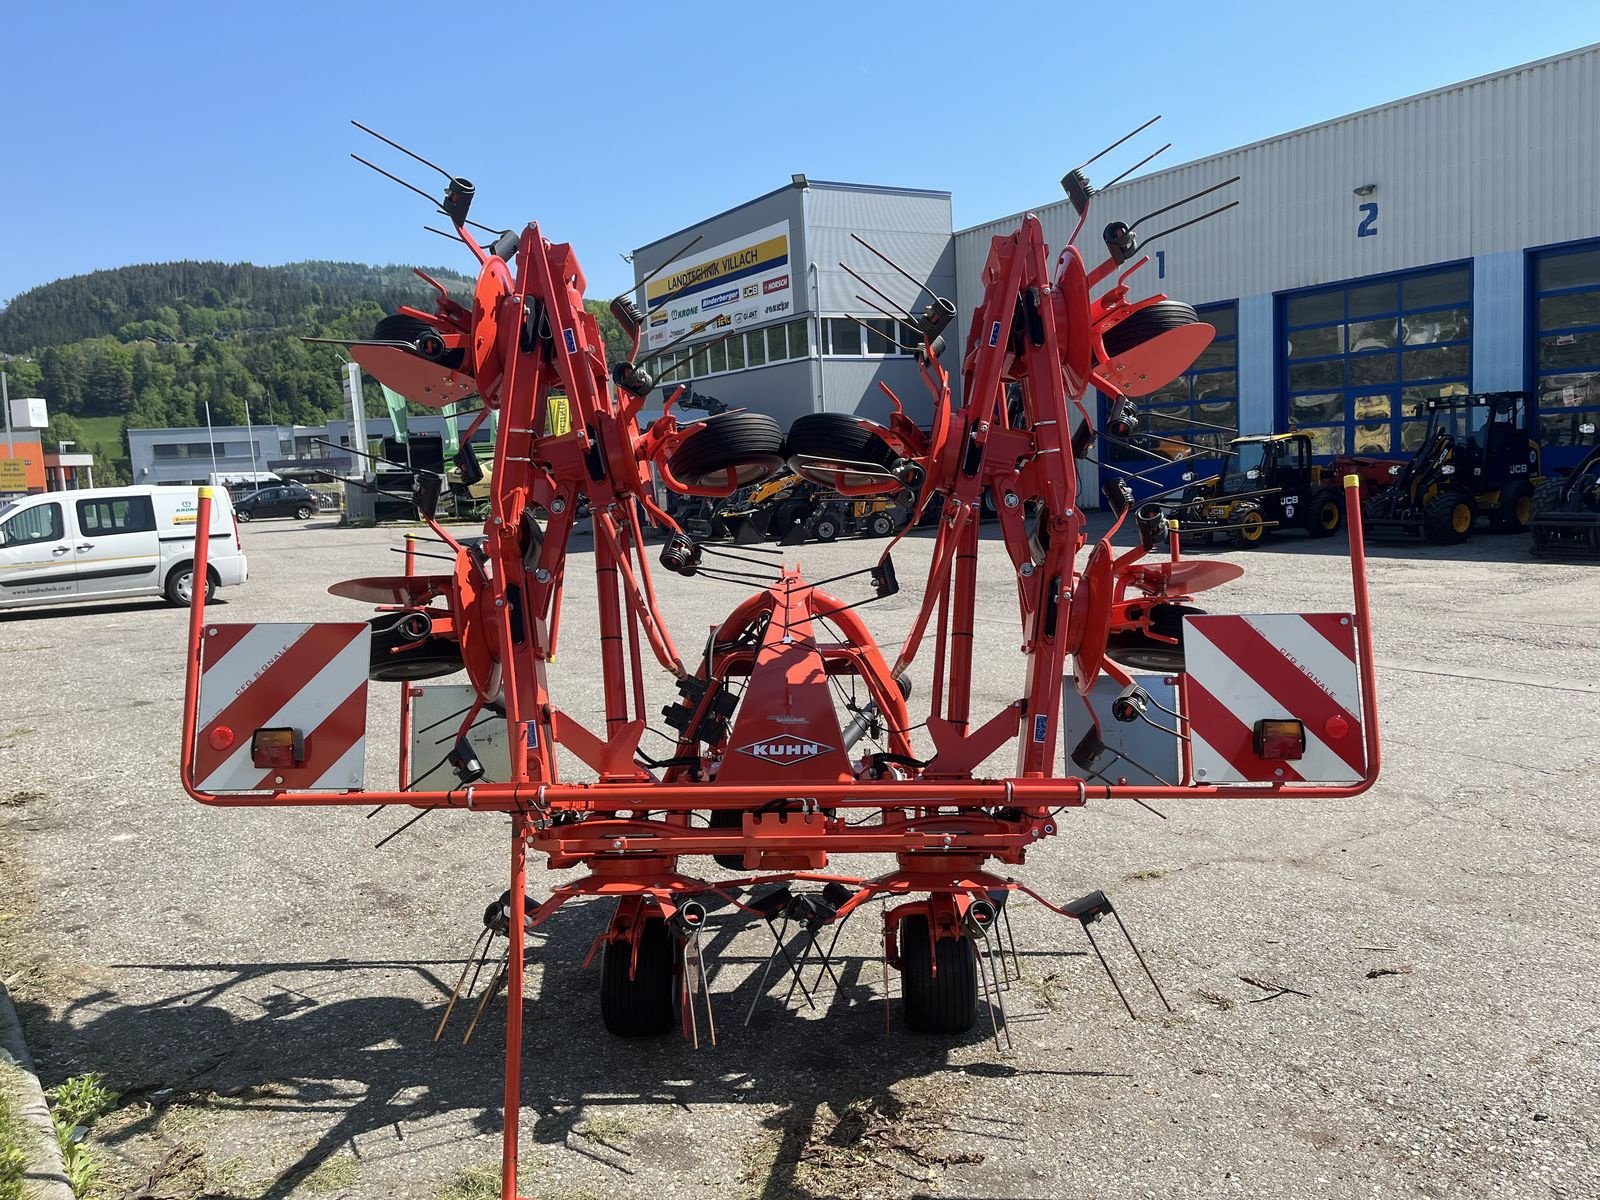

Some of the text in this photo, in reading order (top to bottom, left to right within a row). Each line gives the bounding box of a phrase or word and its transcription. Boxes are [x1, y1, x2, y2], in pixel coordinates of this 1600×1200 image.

[1357, 202, 1379, 238] 2
[667, 248, 758, 291] LANDTECHNIK VILLACH
[1155, 250, 1166, 280] 1
[767, 278, 788, 290] HORSCH
[743, 285, 758, 298] JCB
[677, 305, 699, 319] KRONE
[1509, 464, 1528, 474] JCB
[1280, 495, 1299, 505] JCB
[1209, 508, 1225, 516] JCB
[1279, 647, 1298, 665] CFG
[235, 679, 253, 696] CFG
[753, 744, 818, 756] KUHN
